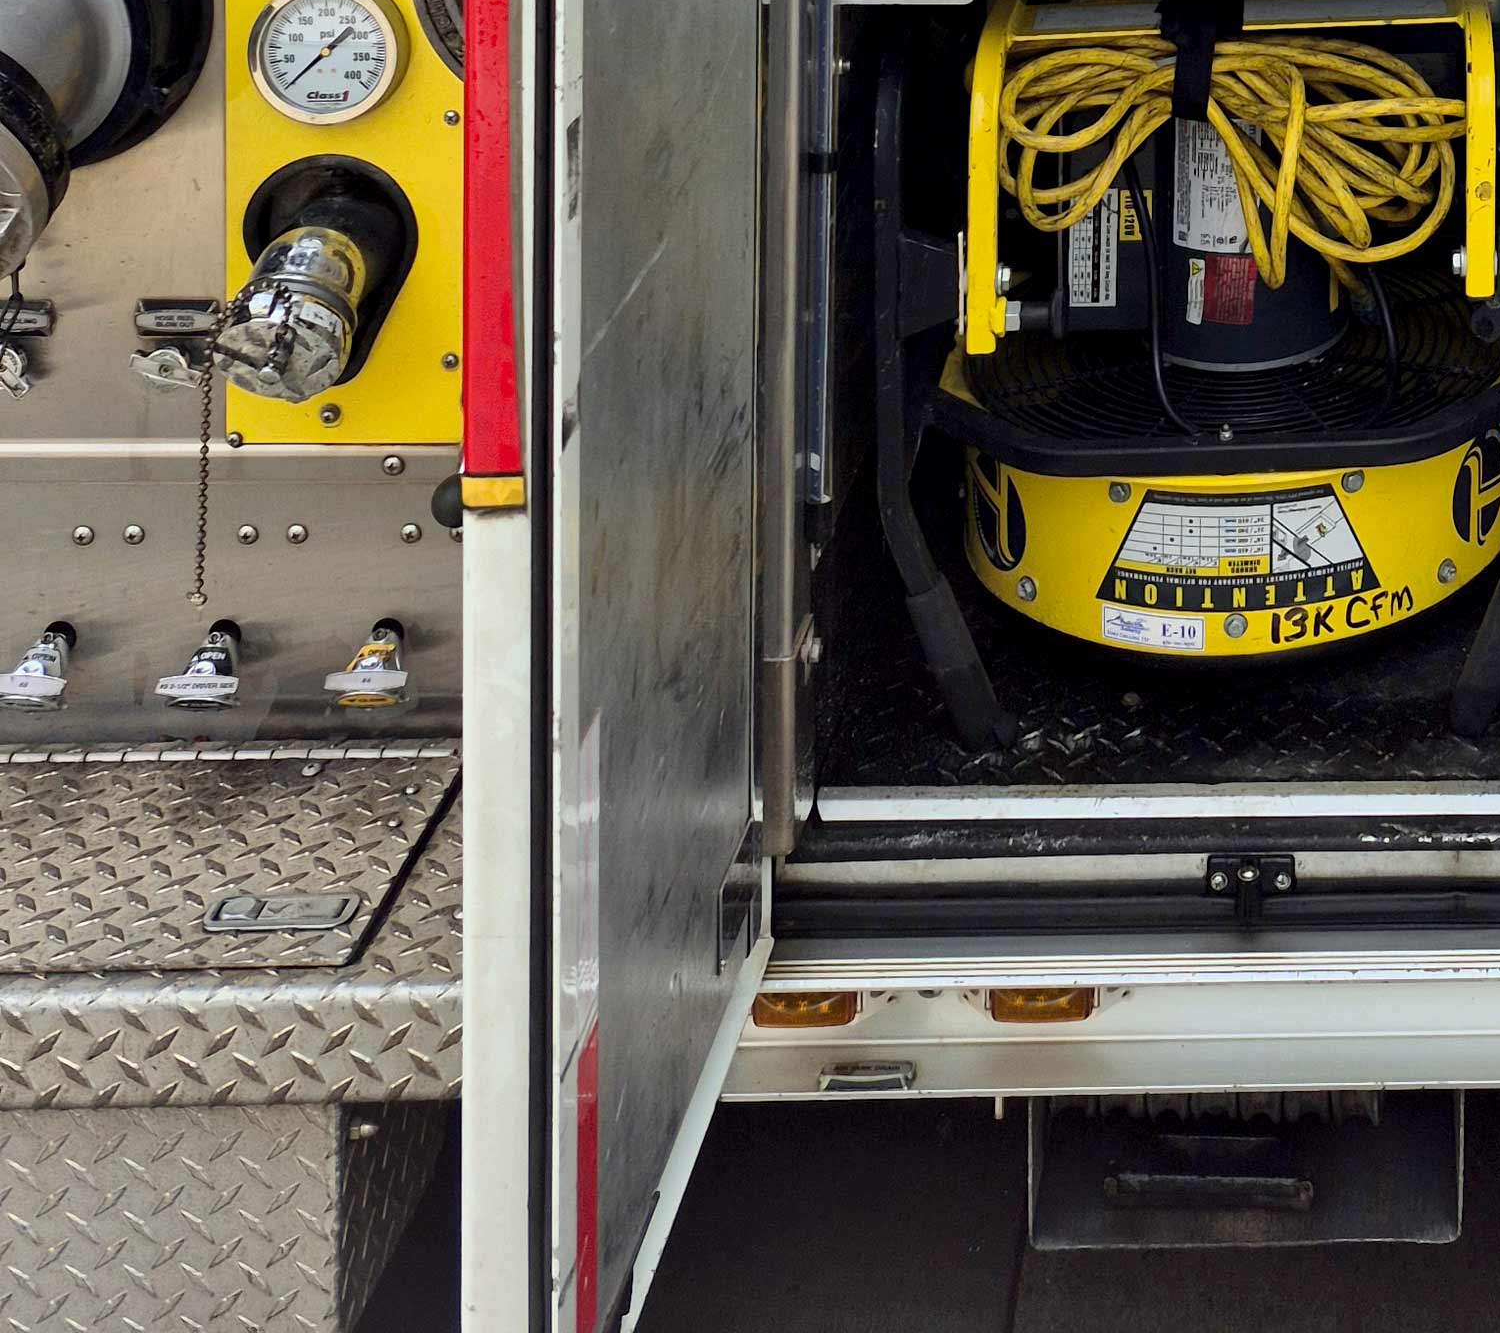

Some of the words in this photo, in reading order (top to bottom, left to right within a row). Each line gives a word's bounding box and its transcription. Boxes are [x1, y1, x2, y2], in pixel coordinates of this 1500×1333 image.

[318, 8, 336, 17] 200
[298, 16, 313, 25] 150
[339, 16, 356, 25] 250
[288, 33, 304, 42] 100
[319, 29, 335, 39] psi
[351, 31, 368, 40] 300
[283, 54, 295, 63] 50
[353, 52, 370, 61] 350
[343, 70, 361, 80] 400
[1114, 569, 1364, 609] ATTENTION
[1271, 604, 1334, 644] 13K
[1347, 585, 1414, 631] CFM
[1161, 623, 1196, 640] E-10
[200, 651, 226, 660] OPEN
